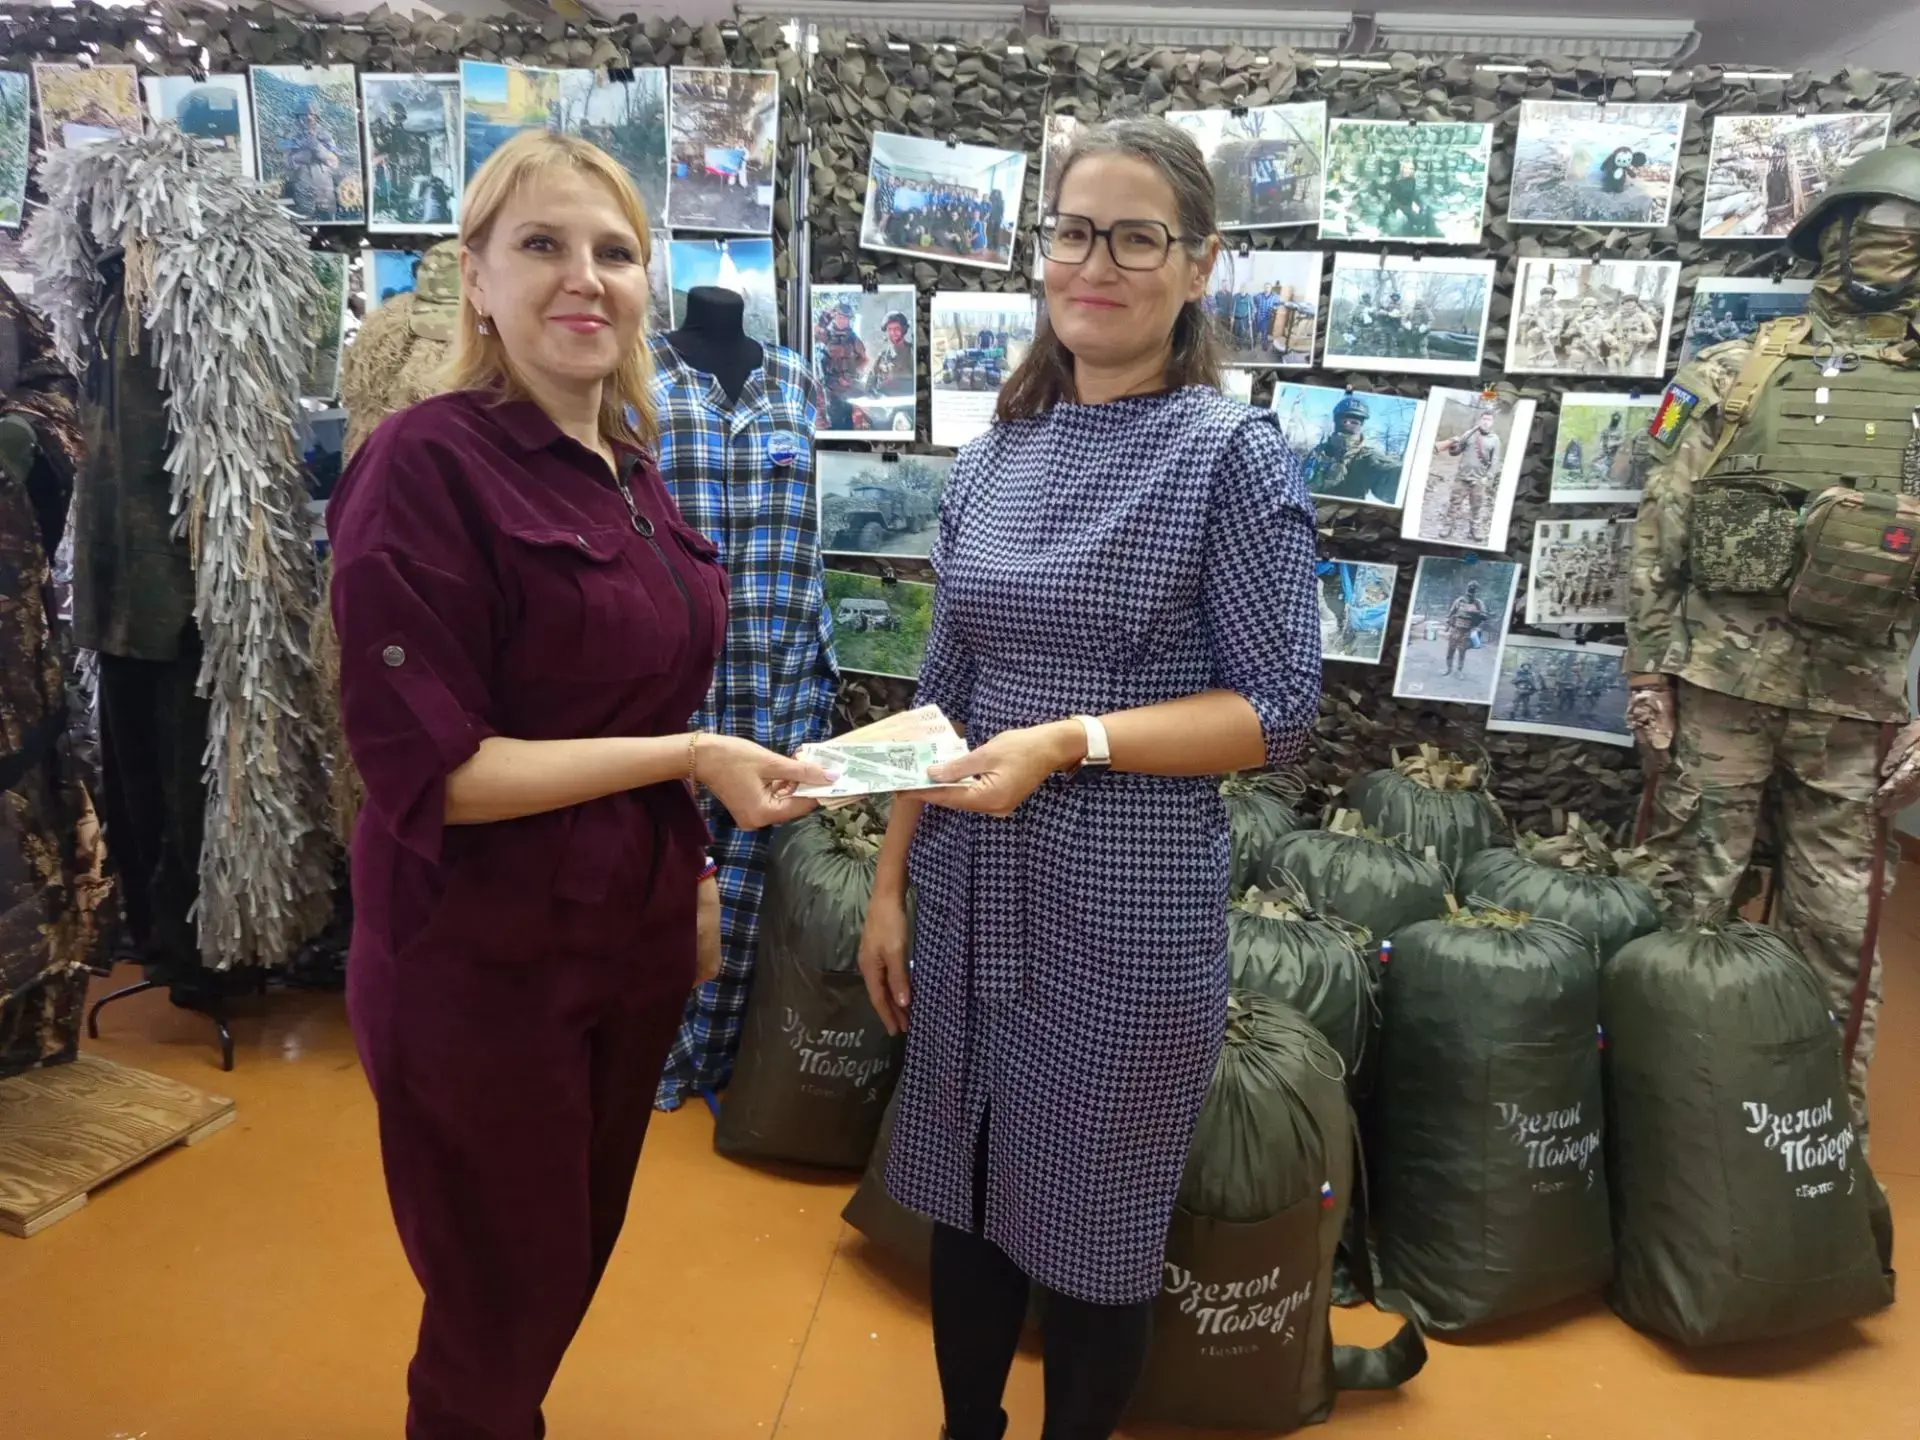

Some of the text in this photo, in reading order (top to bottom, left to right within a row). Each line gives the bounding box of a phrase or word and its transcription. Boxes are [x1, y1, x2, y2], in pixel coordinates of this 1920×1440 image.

[799, 1047, 891, 1088] Победы
[1492, 1101, 1582, 1146] Узелок
[1742, 1097, 1834, 1150] Узелок
[1780, 1121, 1855, 1172] Победы
[1524, 1128, 1600, 1171] Победы
[1163, 1261, 1281, 1315] Узелок
[1196, 1280, 1312, 1334] Победы
